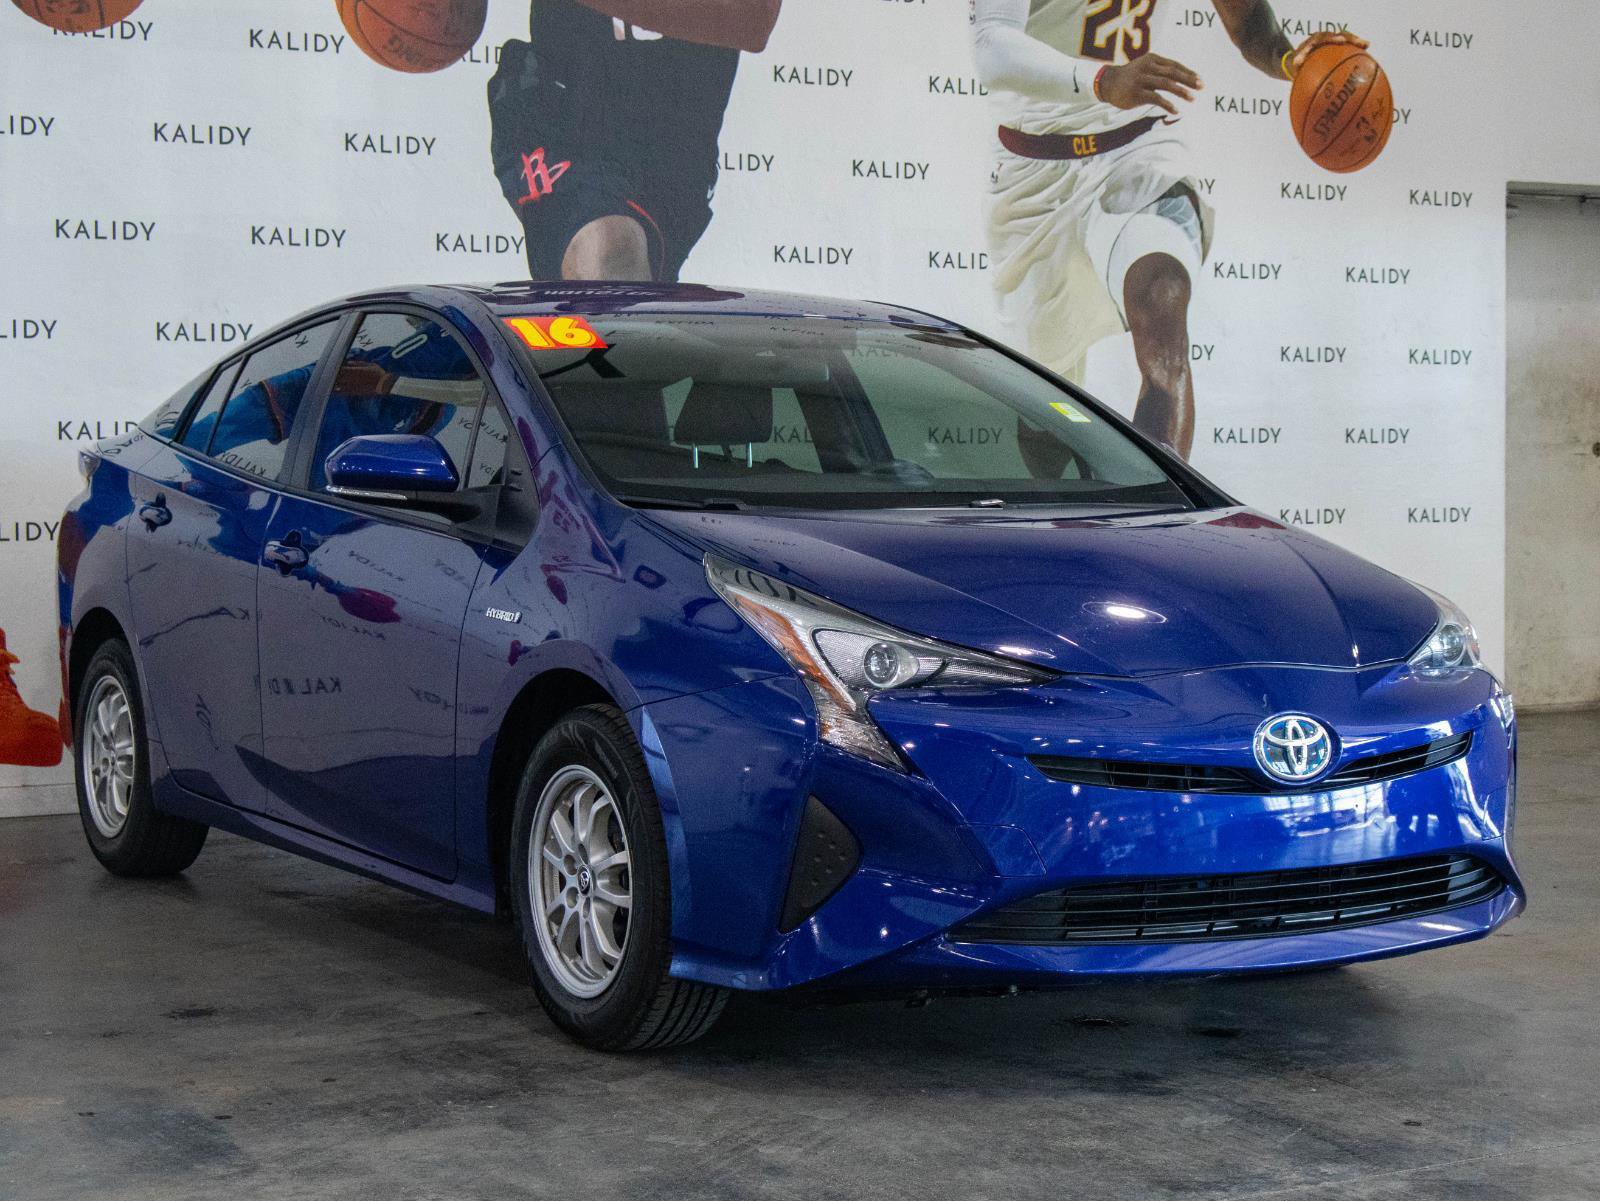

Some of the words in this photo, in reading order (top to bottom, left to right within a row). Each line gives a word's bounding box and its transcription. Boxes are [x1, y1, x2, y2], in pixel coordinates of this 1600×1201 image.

[1081, 0, 1157, 62] 23
[1411, 29, 1473, 49] KALIDY
[249, 29, 345, 54] KALIDY
[774, 66, 852, 86] KALIDY
[1215, 96, 1282, 115] KALIDY
[154, 123, 250, 145] KALIDY
[345, 133, 435, 155] KALIDY
[1073, 136, 1097, 155] CLE
[853, 160, 929, 179] KALIDY
[1281, 183, 1347, 200] KALIDY
[1410, 190, 1472, 207] KALIDY
[56, 219, 155, 240] KALIDY
[252, 226, 345, 247] KALIDY
[436, 233, 525, 255] KALIDY
[775, 246, 852, 264] KALIDY
[1215, 262, 1281, 279] KALIDY
[1346, 267, 1409, 284] KALIDY
[156, 322, 253, 342] KALIDY
[510, 318, 597, 347] 16
[1281, 347, 1346, 362] KALIDY
[1409, 349, 1471, 365] KALIDY
[928, 427, 1002, 444] KALIDY
[1214, 428, 1281, 443] KALIDY
[1346, 428, 1409, 444] KALIDY
[1280, 508, 1345, 524] KALIDY
[1408, 507, 1470, 523] KALIDY
[486, 607, 515, 622] HYBRID
